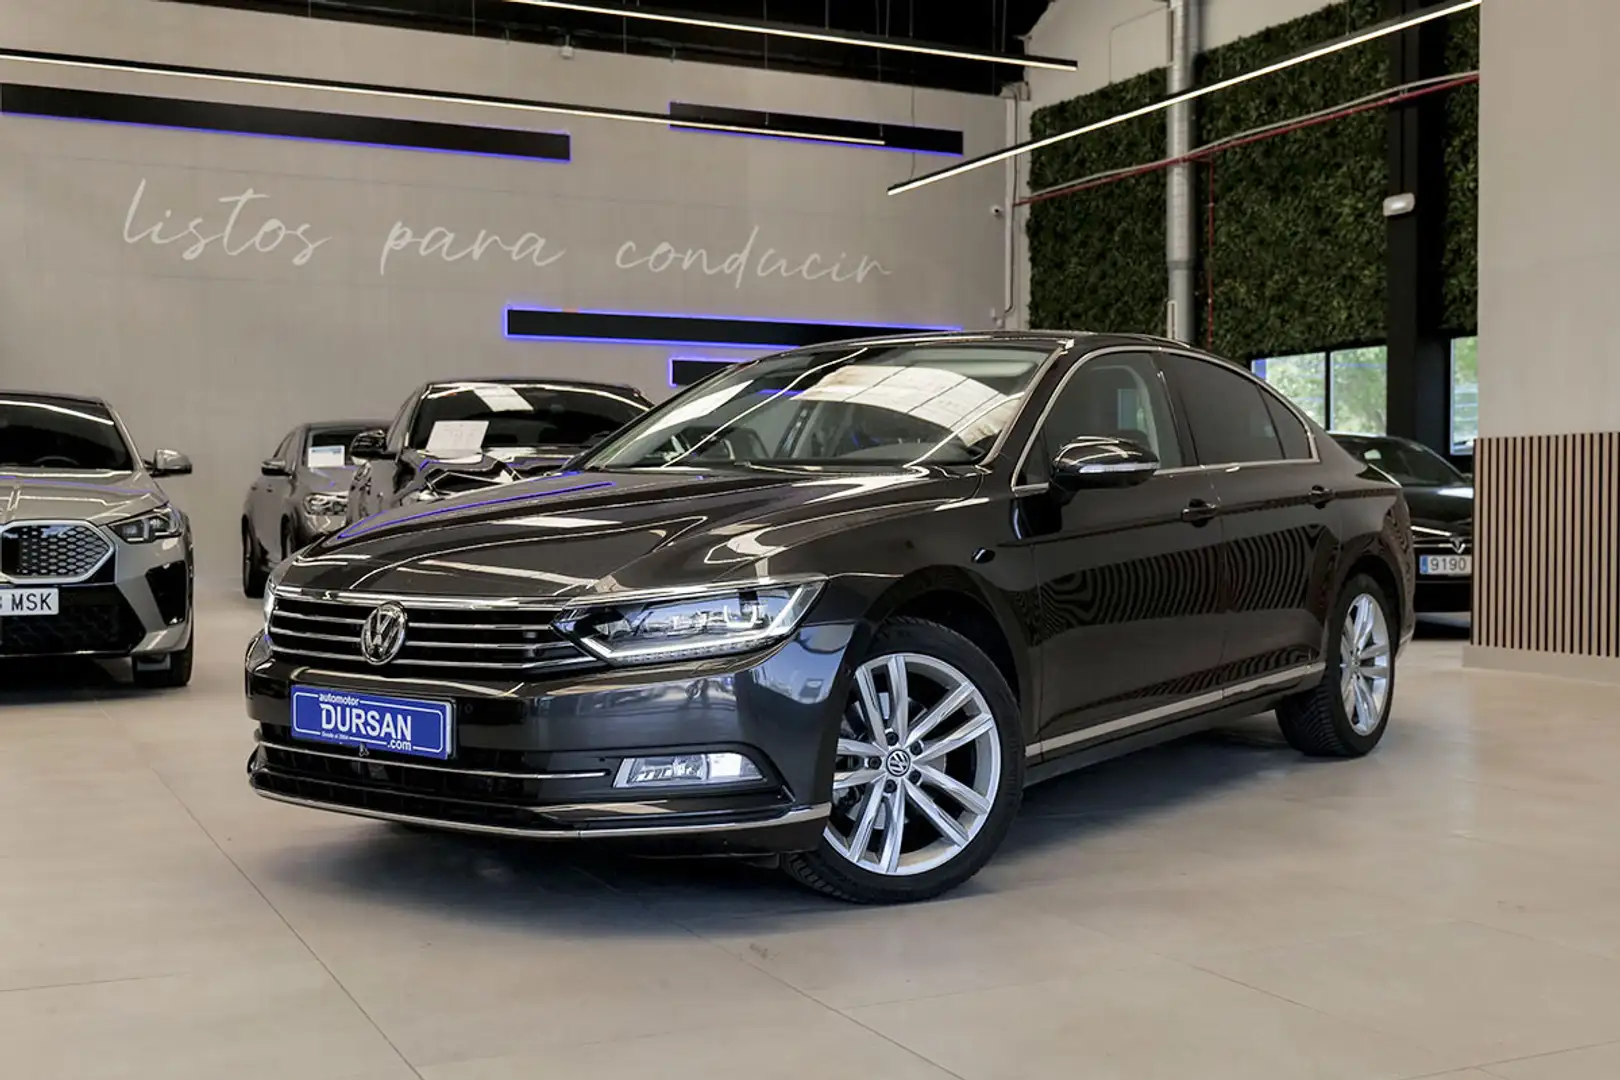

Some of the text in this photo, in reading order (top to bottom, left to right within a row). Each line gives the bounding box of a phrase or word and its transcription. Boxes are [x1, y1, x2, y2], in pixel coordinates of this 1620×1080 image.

[124, 178, 893, 289] listos para conducir
[1430, 557, 1466, 571] 9190
[11, 592, 52, 611] MSK
[319, 693, 359, 706] automotor
[319, 703, 412, 741] DURSAN
[387, 738, 412, 752] .com
